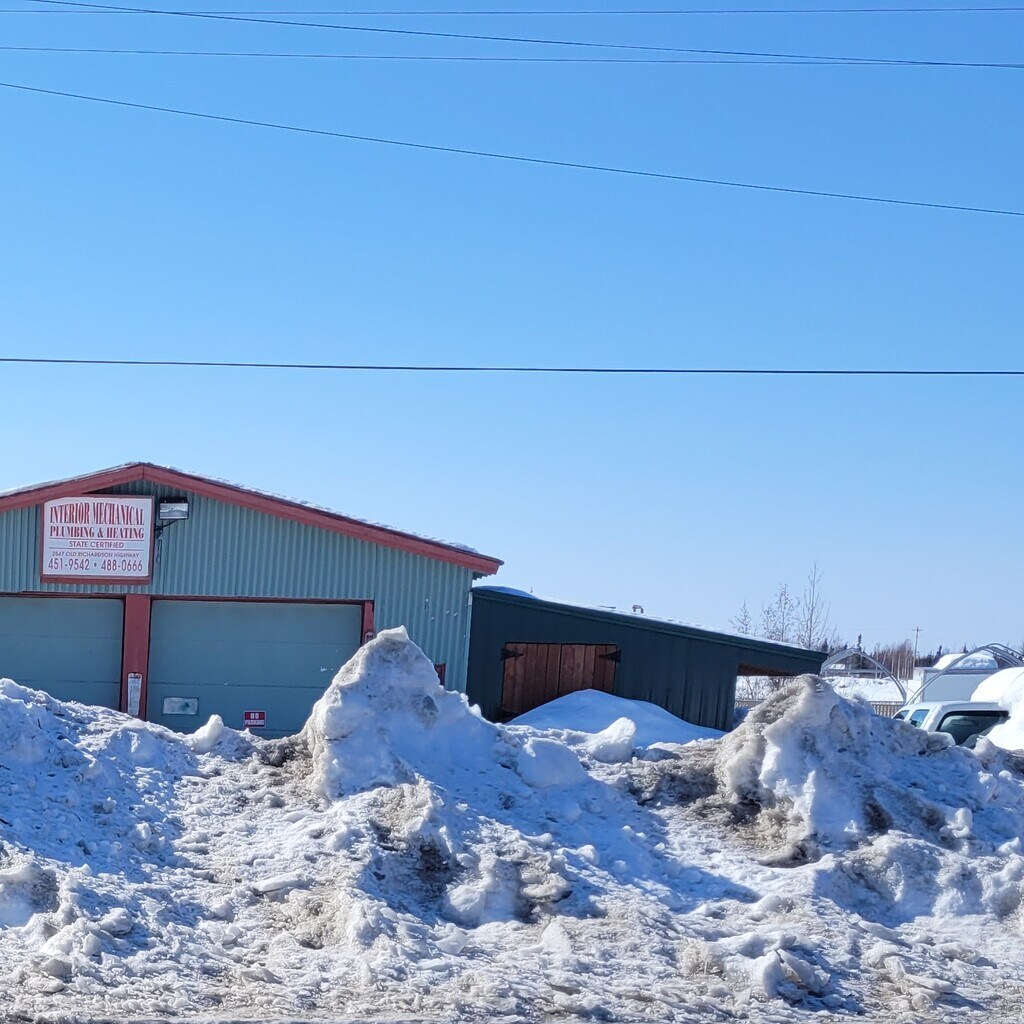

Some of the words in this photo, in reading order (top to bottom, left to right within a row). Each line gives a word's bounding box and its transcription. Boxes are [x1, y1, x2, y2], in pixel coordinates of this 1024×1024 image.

[50, 502, 90, 524] INTERIOR
[92, 502, 144, 526] MECHANICAL
[50, 525, 94, 538] PLUMBING
[97, 527, 104, 538] &
[106, 527, 144, 539] HEATING
[48, 558, 90, 571] 451-9542
[101, 559, 143, 572] 488-0666
[250, 712, 260, 720] NO
